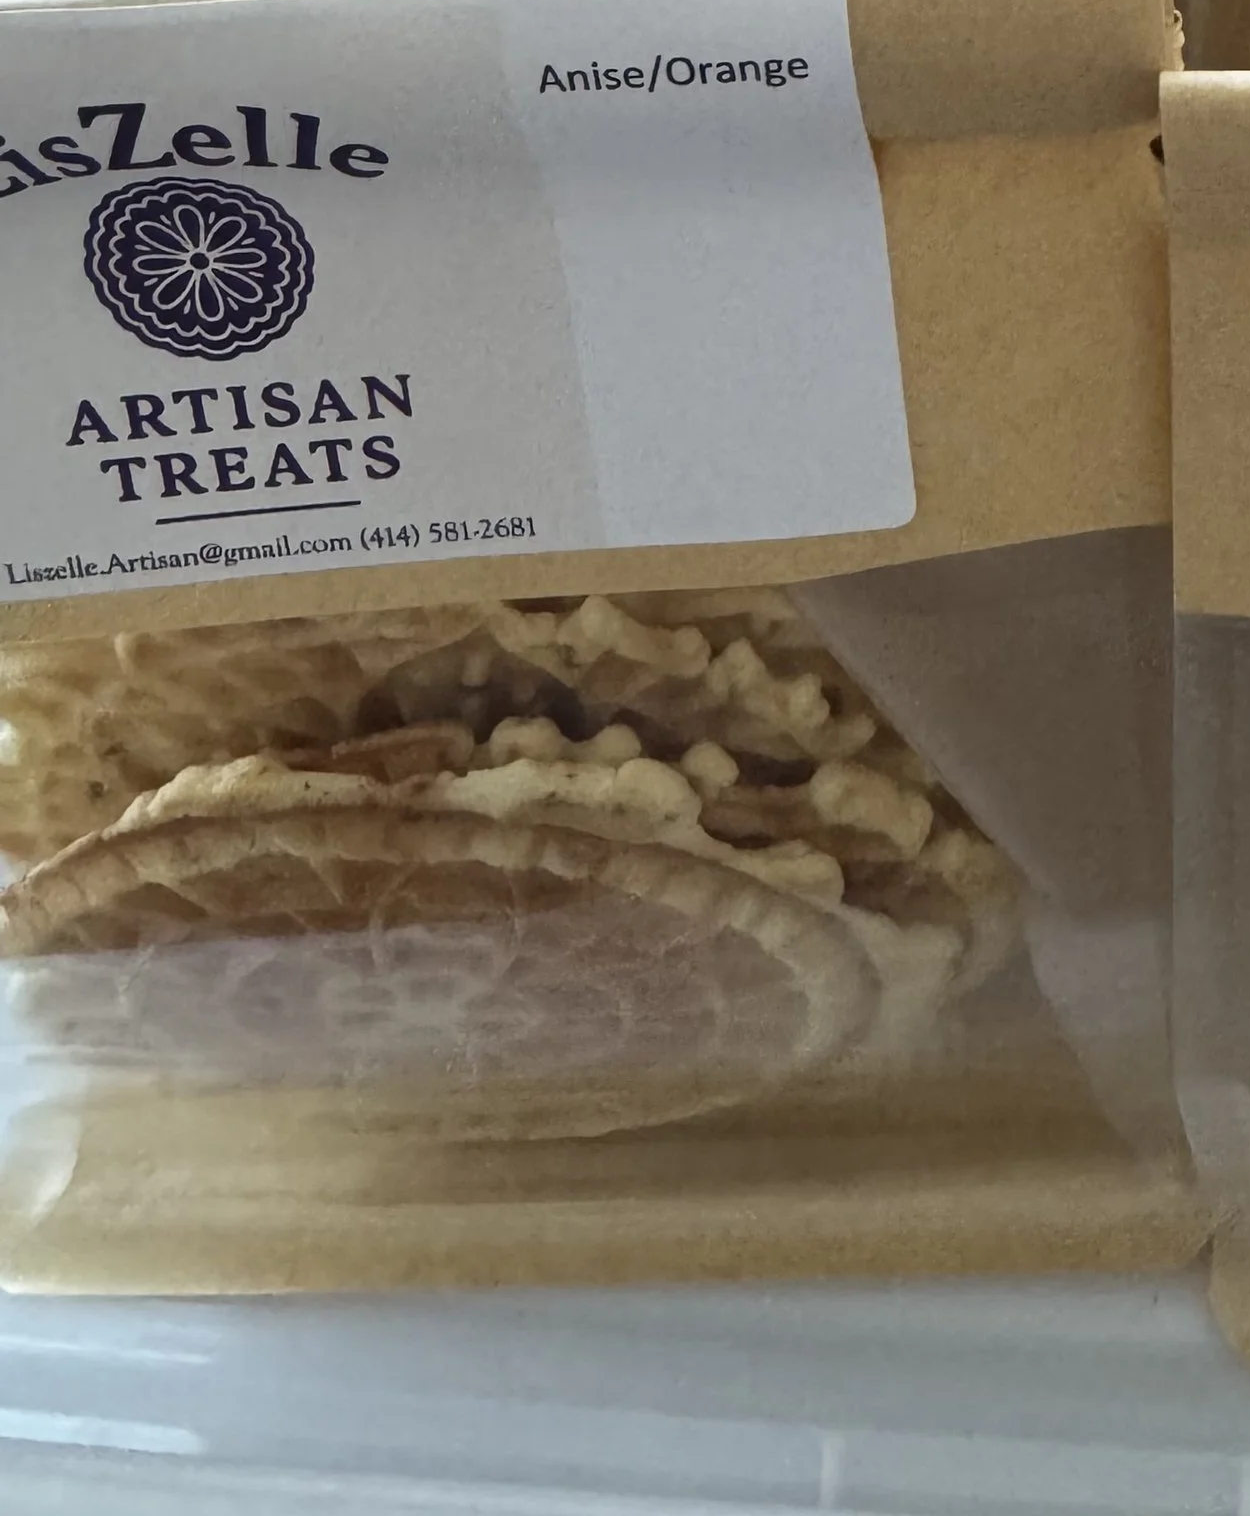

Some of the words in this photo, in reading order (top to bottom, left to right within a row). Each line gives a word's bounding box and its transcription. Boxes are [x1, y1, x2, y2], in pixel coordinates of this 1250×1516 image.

[540, 55, 808, 93] Anise/Orange
[0, 103, 389, 198] isZelle
[66, 374, 412, 446] ARTISAN
[100, 435, 402, 503] TREATS
[361, 524, 419, 551] (414)
[430, 517, 535, 543] 581-2681
